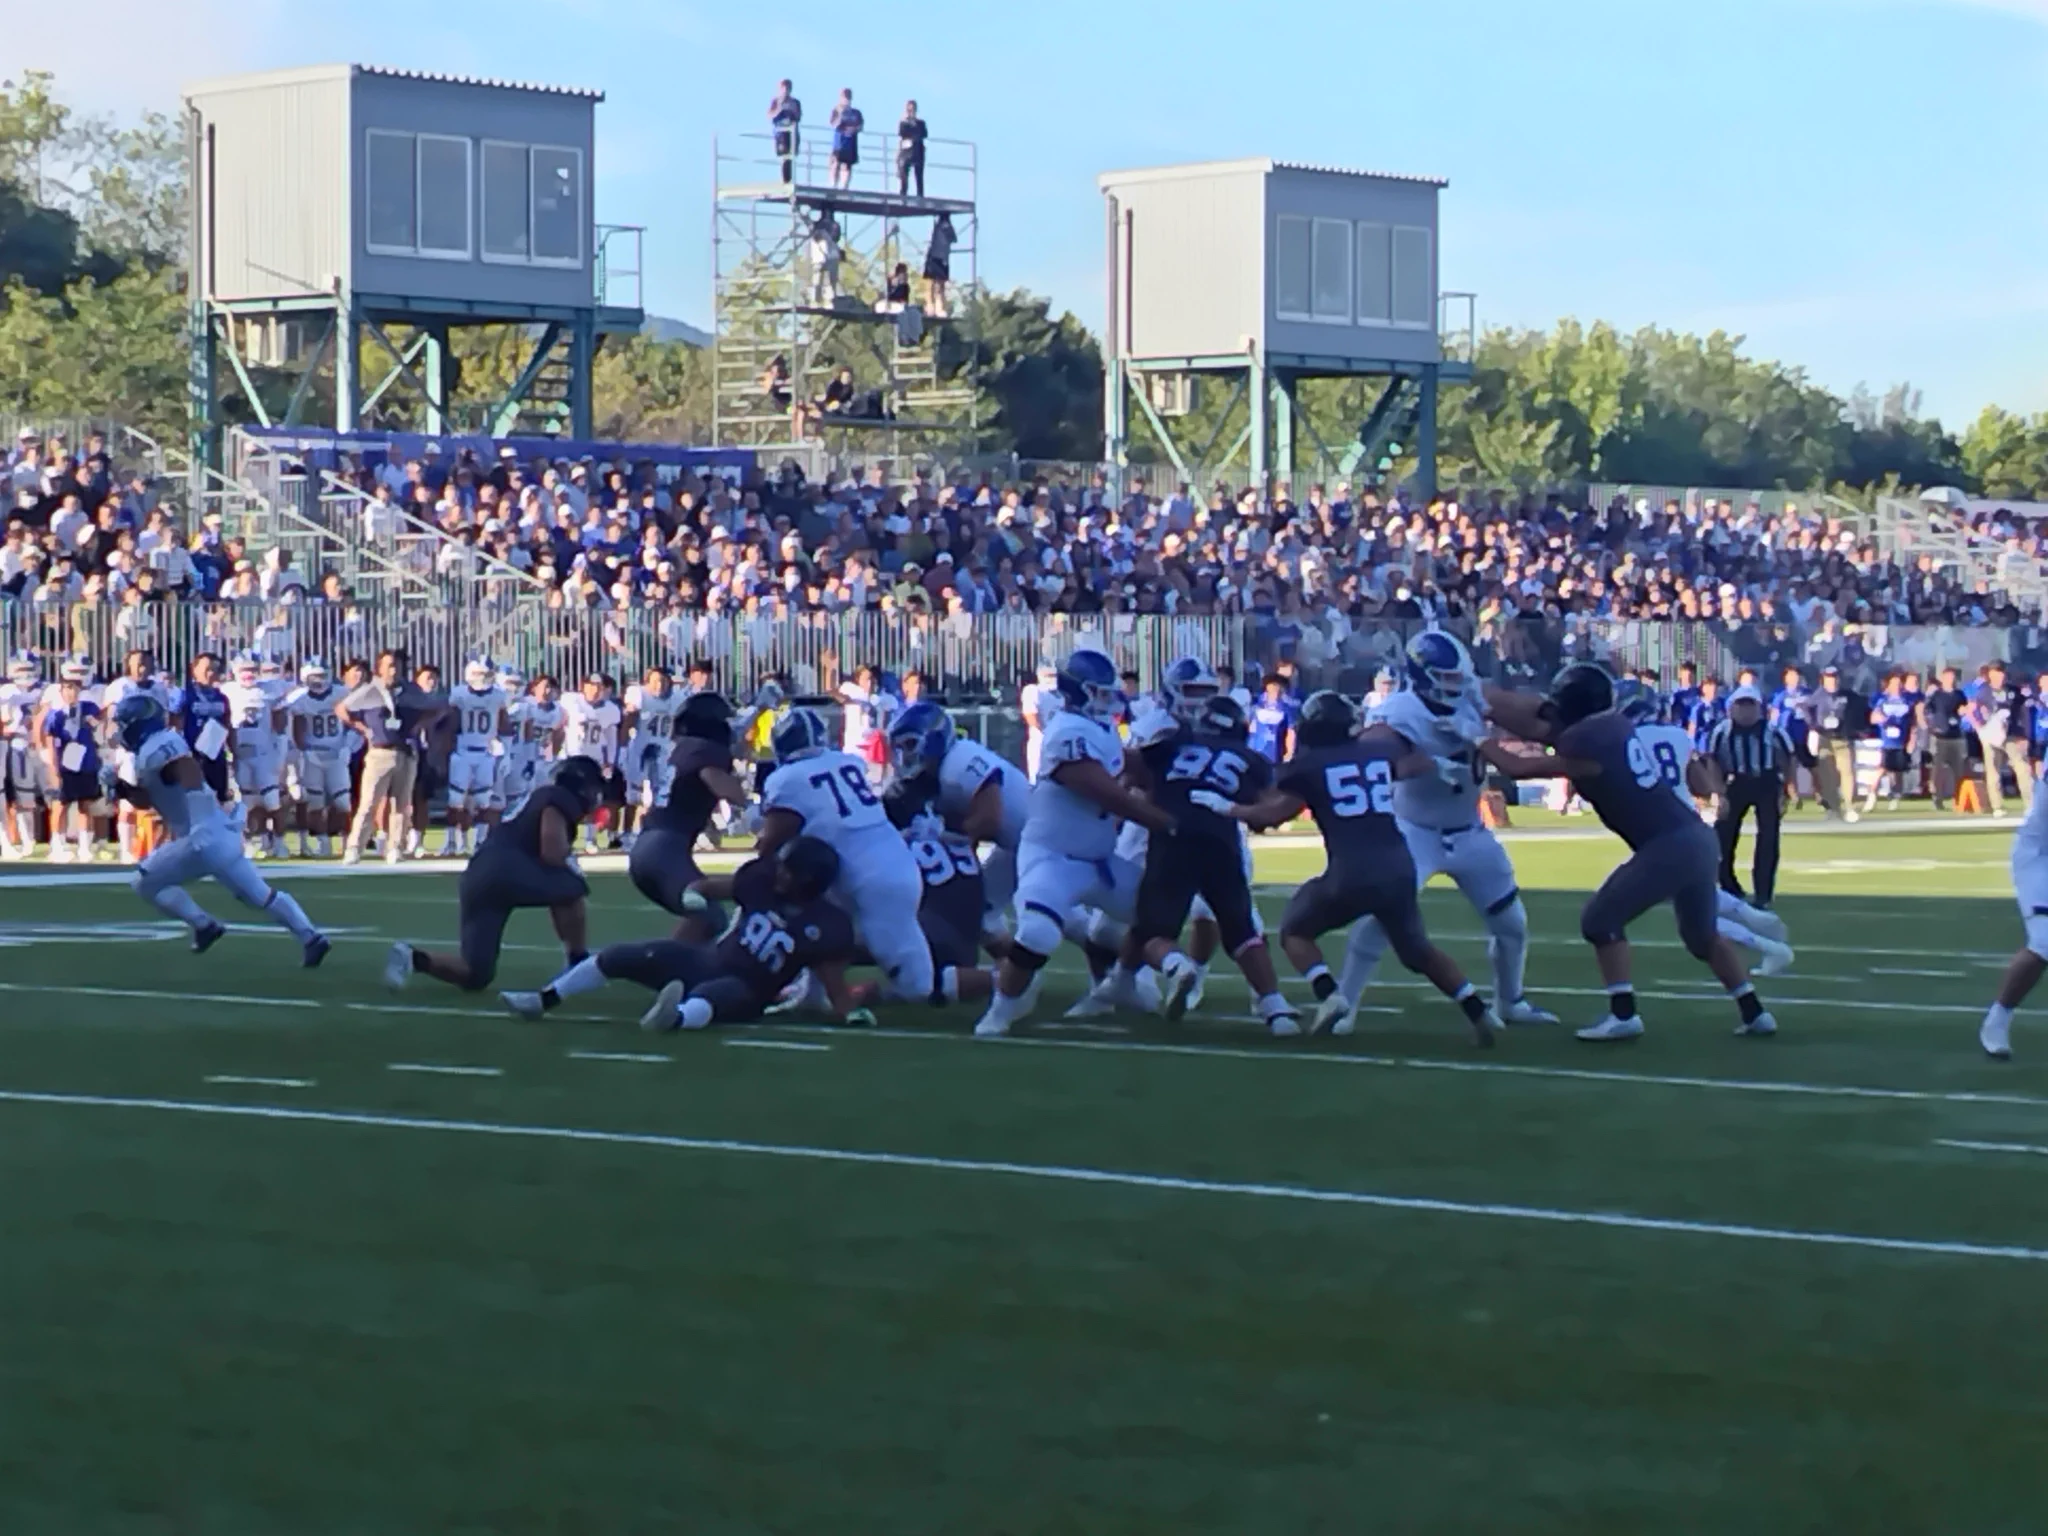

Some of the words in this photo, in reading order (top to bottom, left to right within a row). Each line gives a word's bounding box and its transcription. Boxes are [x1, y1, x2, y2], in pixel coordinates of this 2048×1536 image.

[808, 763, 879, 819] 78
[1166, 745, 1249, 795] 95
[1325, 760, 1394, 817] 52
